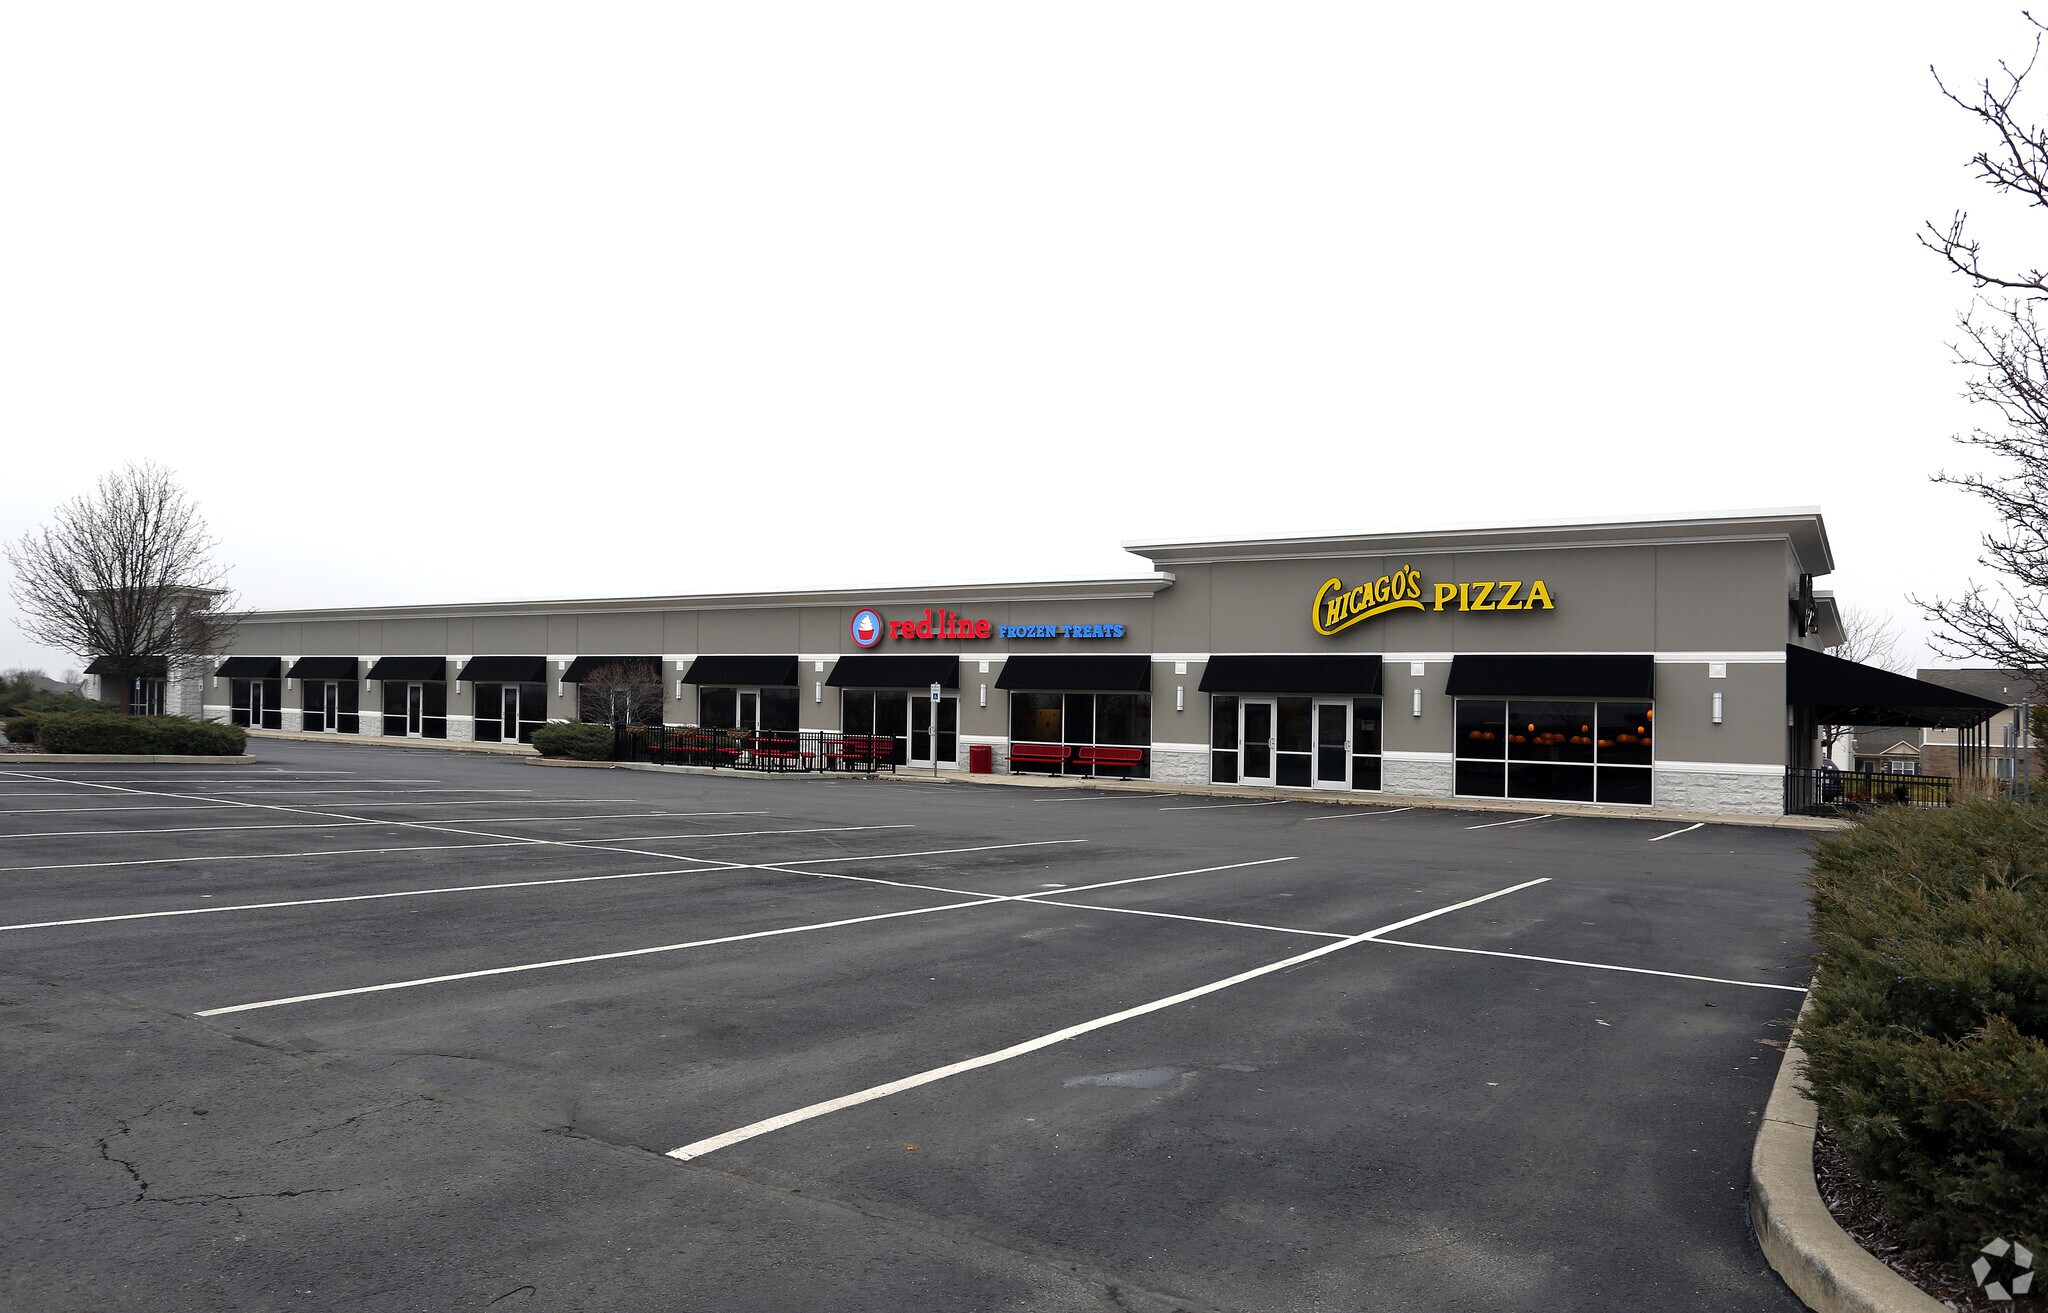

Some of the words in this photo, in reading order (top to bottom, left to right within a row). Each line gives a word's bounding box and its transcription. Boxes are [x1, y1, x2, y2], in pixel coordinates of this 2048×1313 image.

[889, 609, 933, 639] red
[937, 609, 991, 639] line
[999, 625, 1057, 638] FROZEN
[1062, 624, 1124, 638] TREATS
[1311, 564, 1425, 636] CHICAGO'S
[1433, 580, 1555, 612] PIZZA
